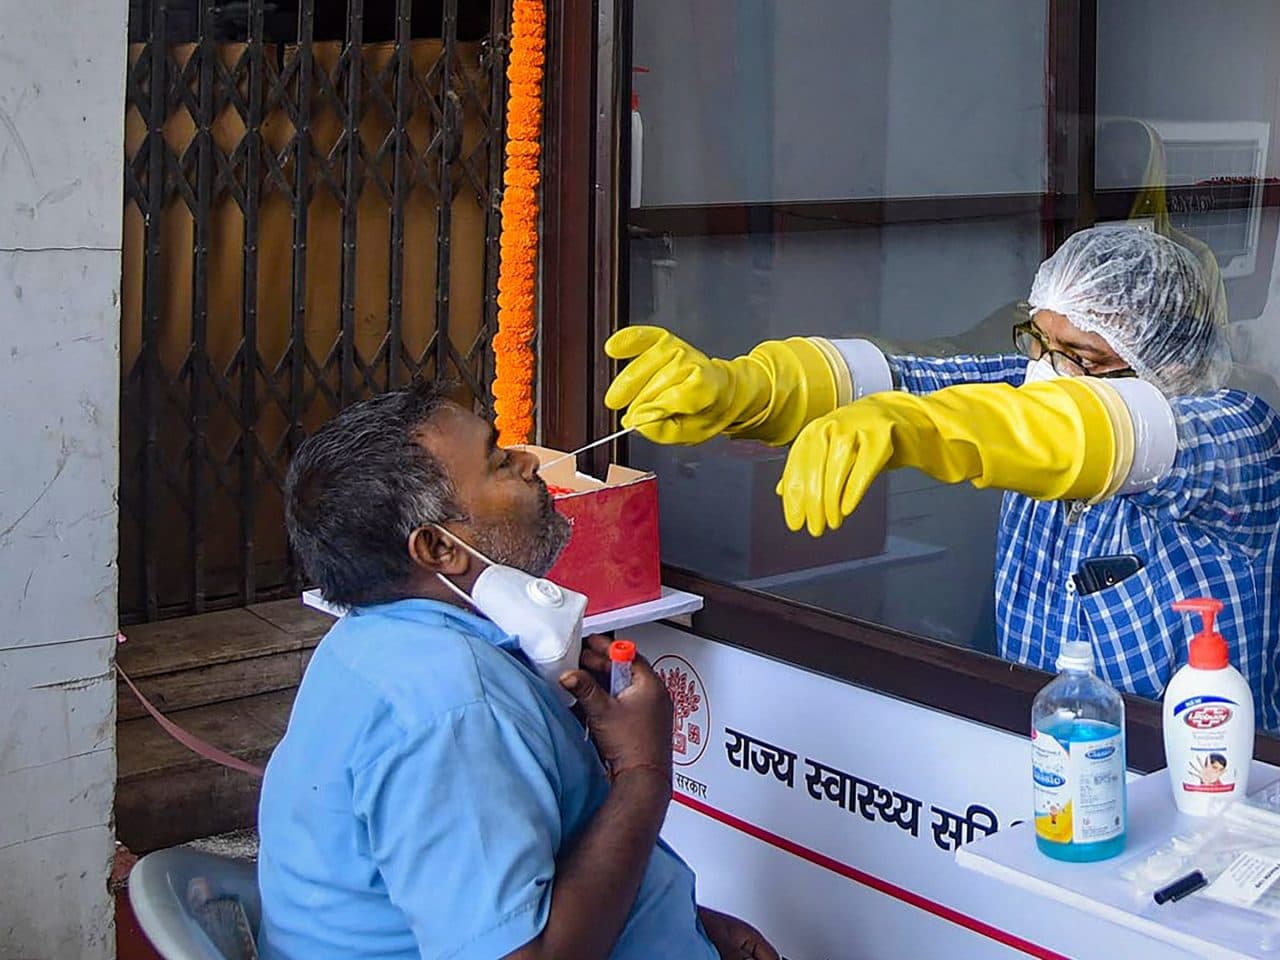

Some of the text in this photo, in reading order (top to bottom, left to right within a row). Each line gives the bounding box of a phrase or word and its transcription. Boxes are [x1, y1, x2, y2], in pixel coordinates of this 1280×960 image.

[674, 773, 707, 799] सरकार
[724, 726, 798, 788] राज्य
[804, 758, 922, 838] स्वास्थ्य
